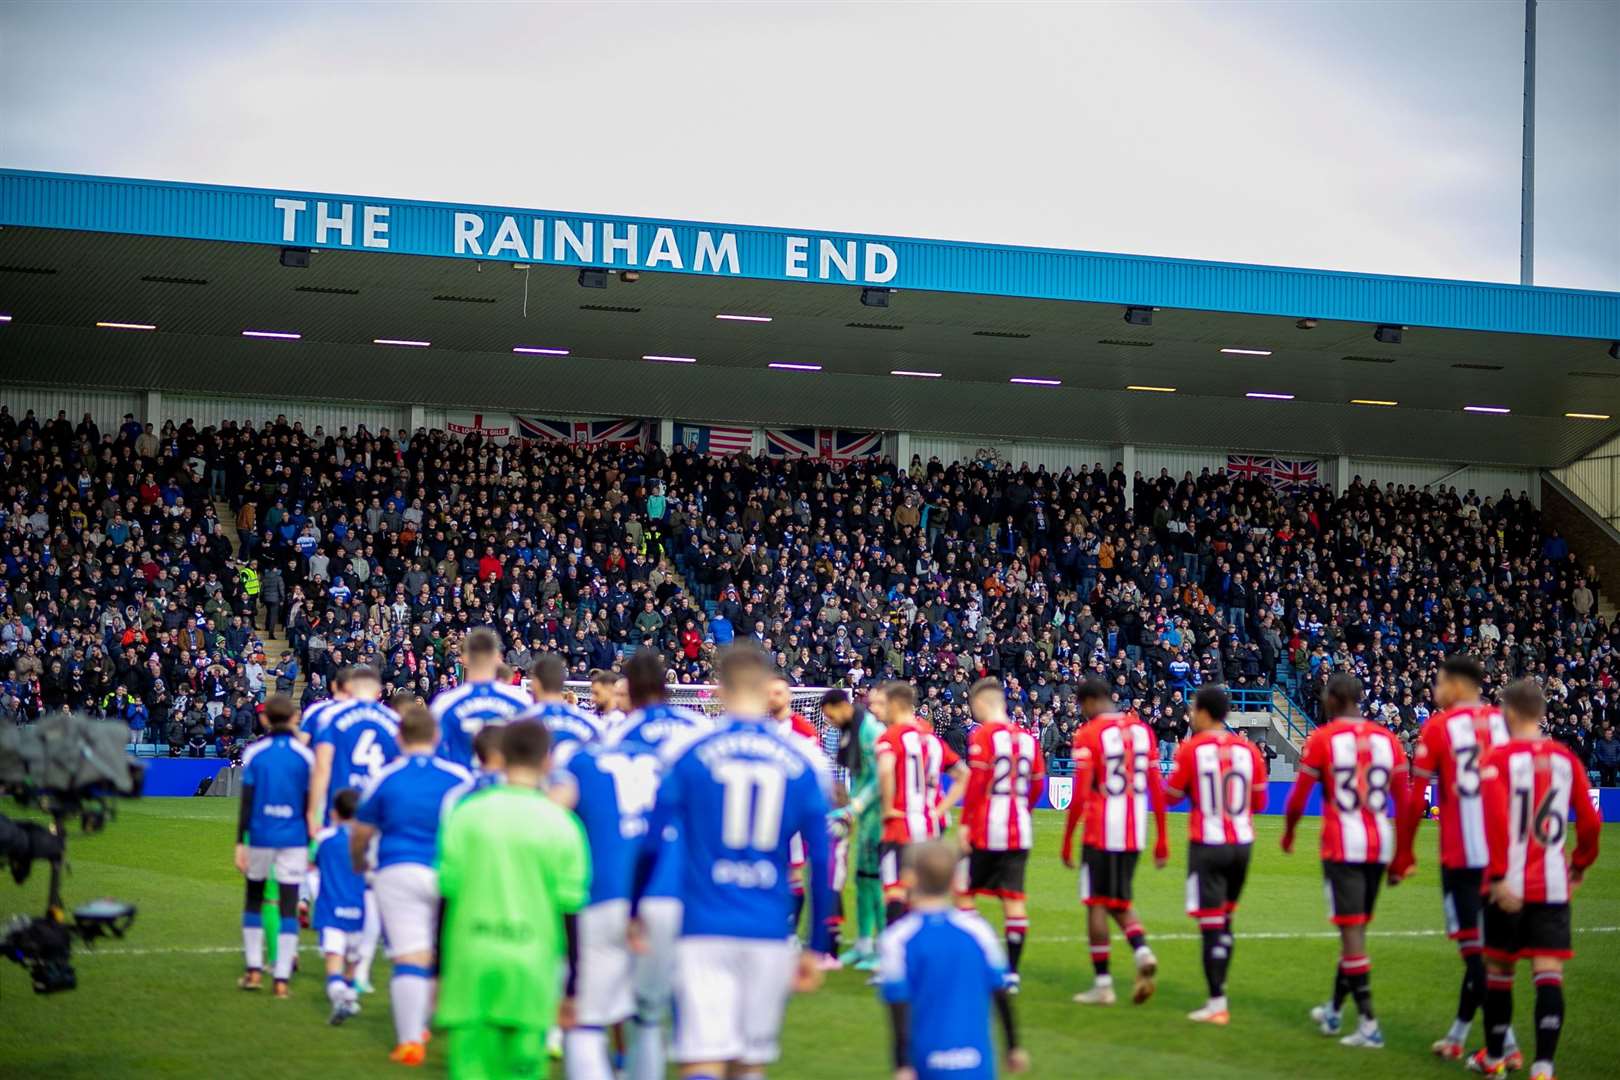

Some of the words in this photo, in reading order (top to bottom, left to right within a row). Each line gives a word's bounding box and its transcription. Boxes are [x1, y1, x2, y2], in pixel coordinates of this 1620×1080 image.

[274, 198, 390, 249] THE
[454, 212, 741, 275] RAINHAM
[785, 237, 899, 284] END
[351, 728, 385, 778] 4
[1454, 745, 1482, 798] 3
[712, 761, 786, 852] 11
[1201, 771, 1248, 816] 10
[1333, 766, 1389, 812] 38
[1515, 786, 1563, 847] 16
